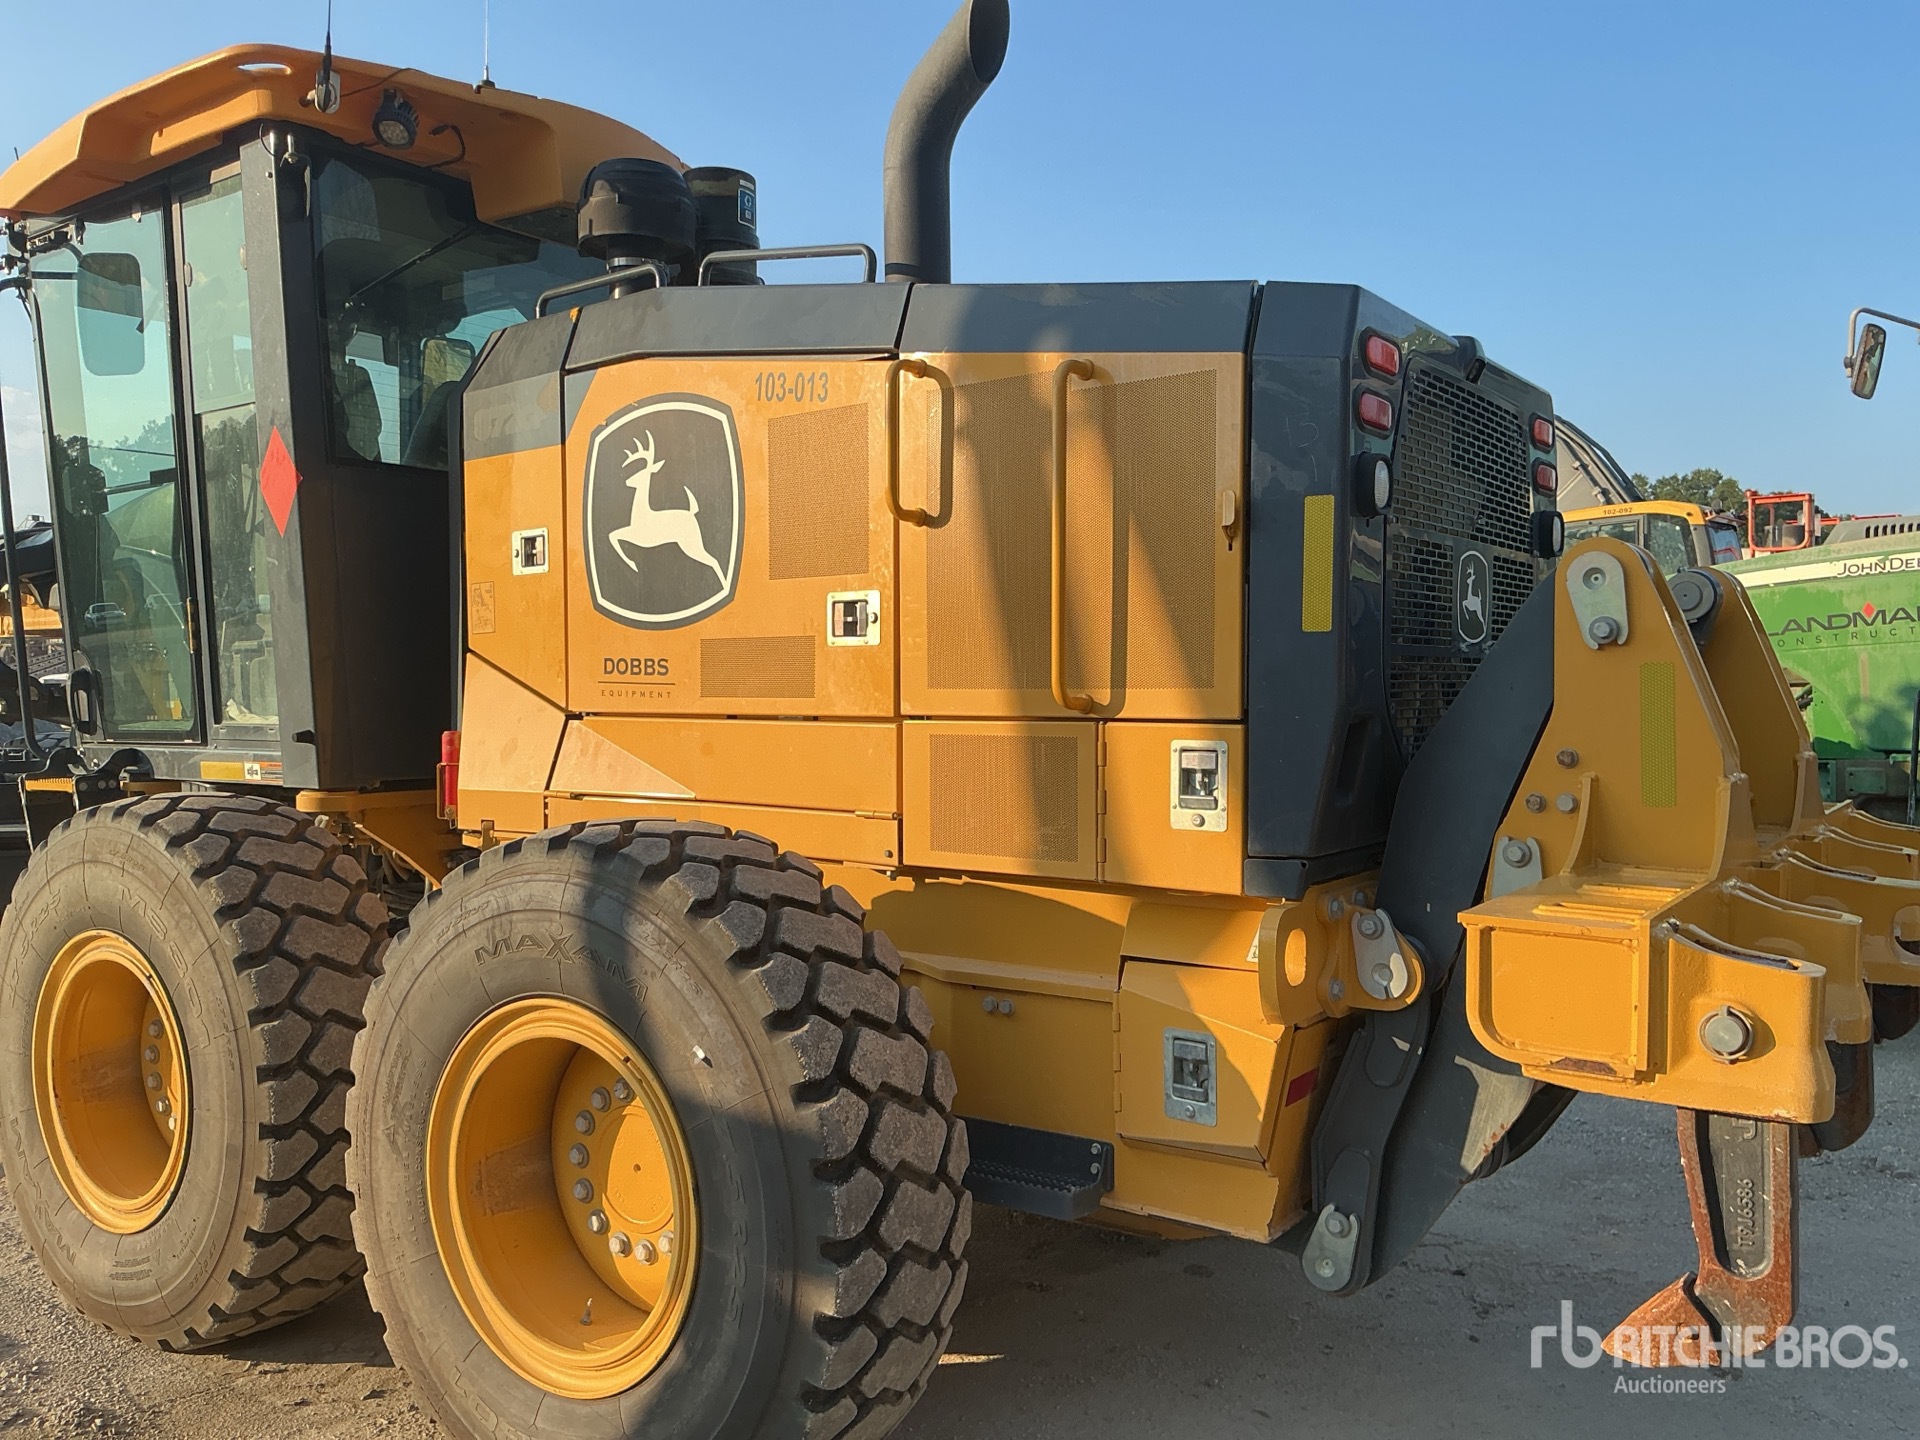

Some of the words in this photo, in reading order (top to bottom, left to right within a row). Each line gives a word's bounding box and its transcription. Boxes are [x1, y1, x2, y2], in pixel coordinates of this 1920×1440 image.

[755, 372, 829, 402] 103-013
[1603, 507, 1633, 516] 102-092
[1889, 557, 1920, 571] DE
[1768, 605, 1920, 637] ANDMA
[1776, 626, 1916, 648] ONSTRUCT
[603, 657, 669, 676] DOBBS
[601, 689, 671, 698] EQUIPMENT
[473, 933, 649, 1003] MAXAM
